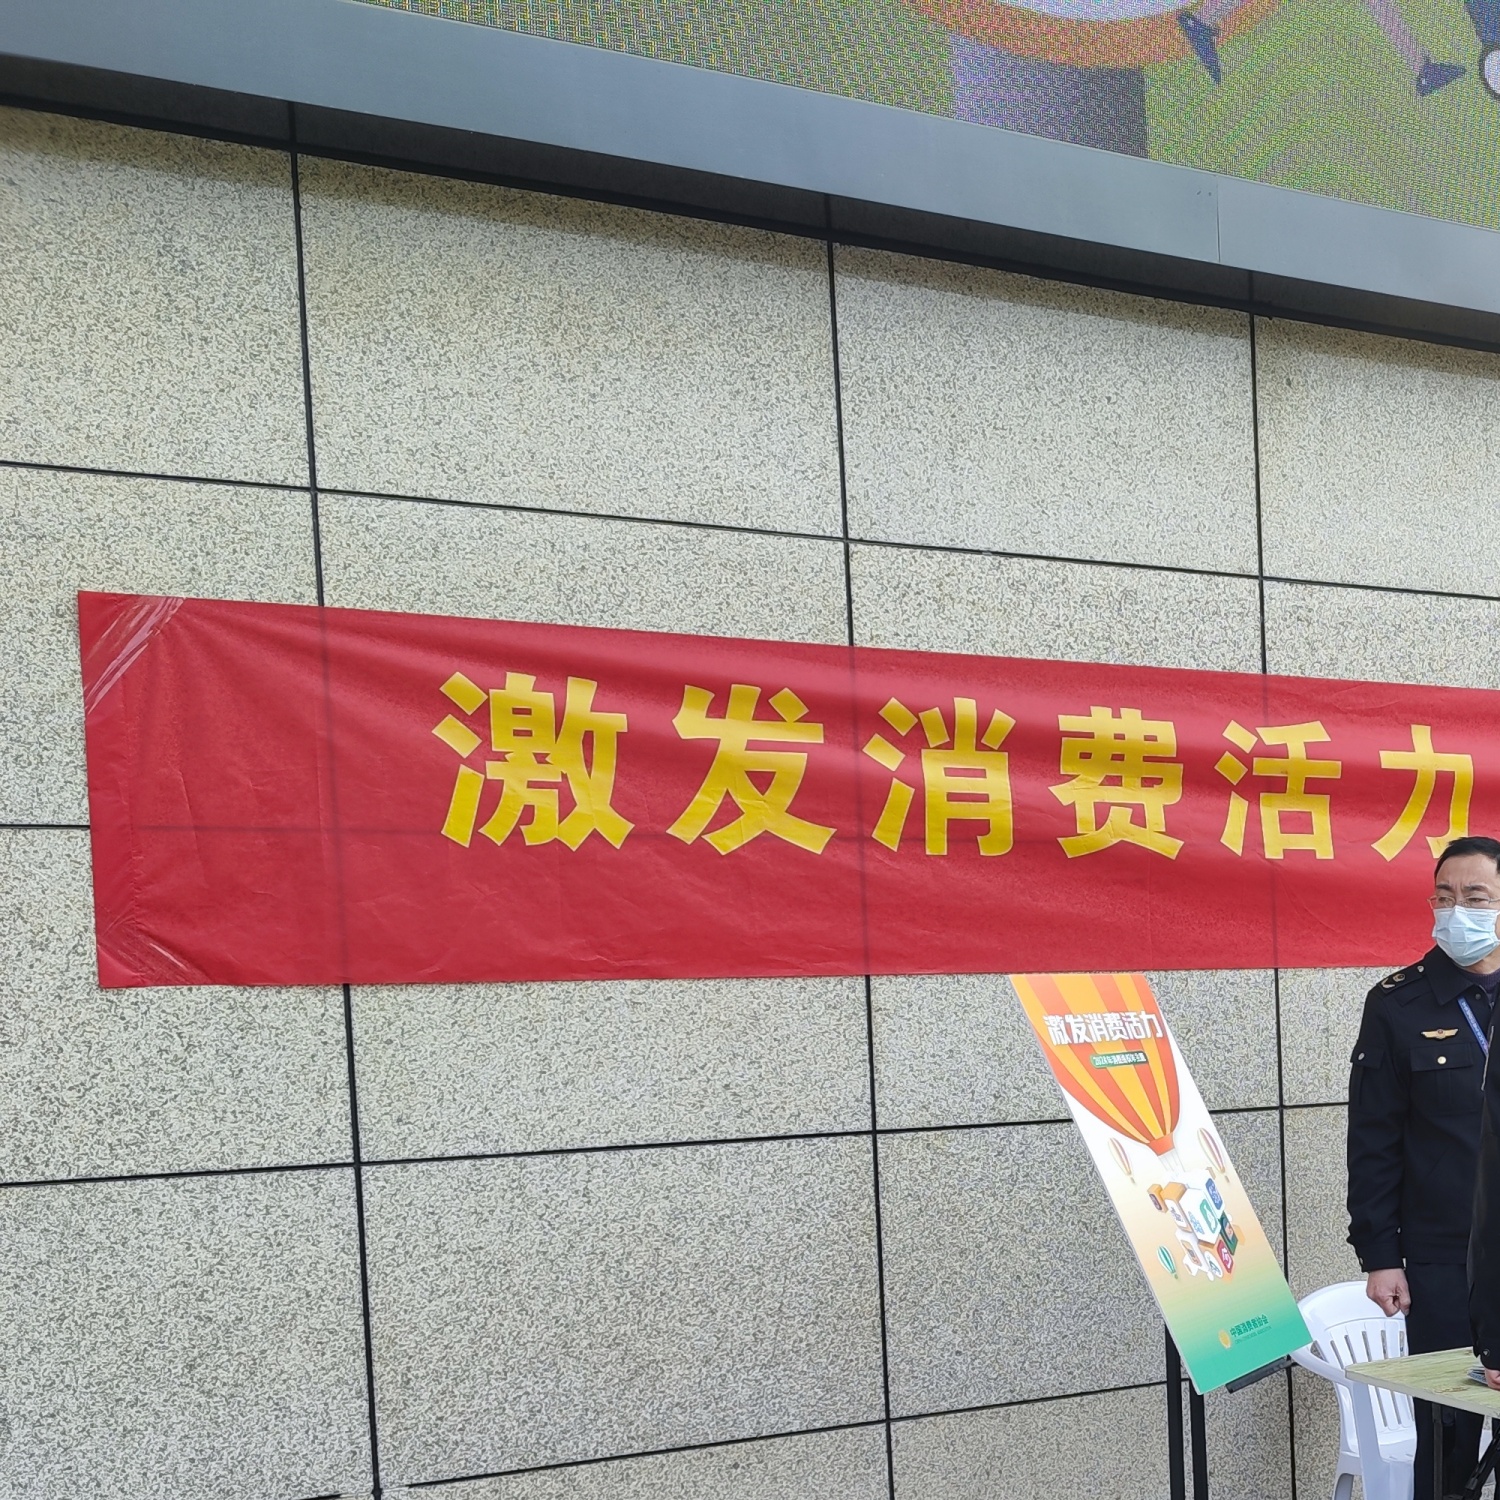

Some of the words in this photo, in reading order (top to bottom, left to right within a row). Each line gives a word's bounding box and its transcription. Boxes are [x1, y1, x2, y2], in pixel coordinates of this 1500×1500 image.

[431, 671, 1474, 861] 激发消费活力
[1042, 1011, 1164, 1046] 激发消费活力
